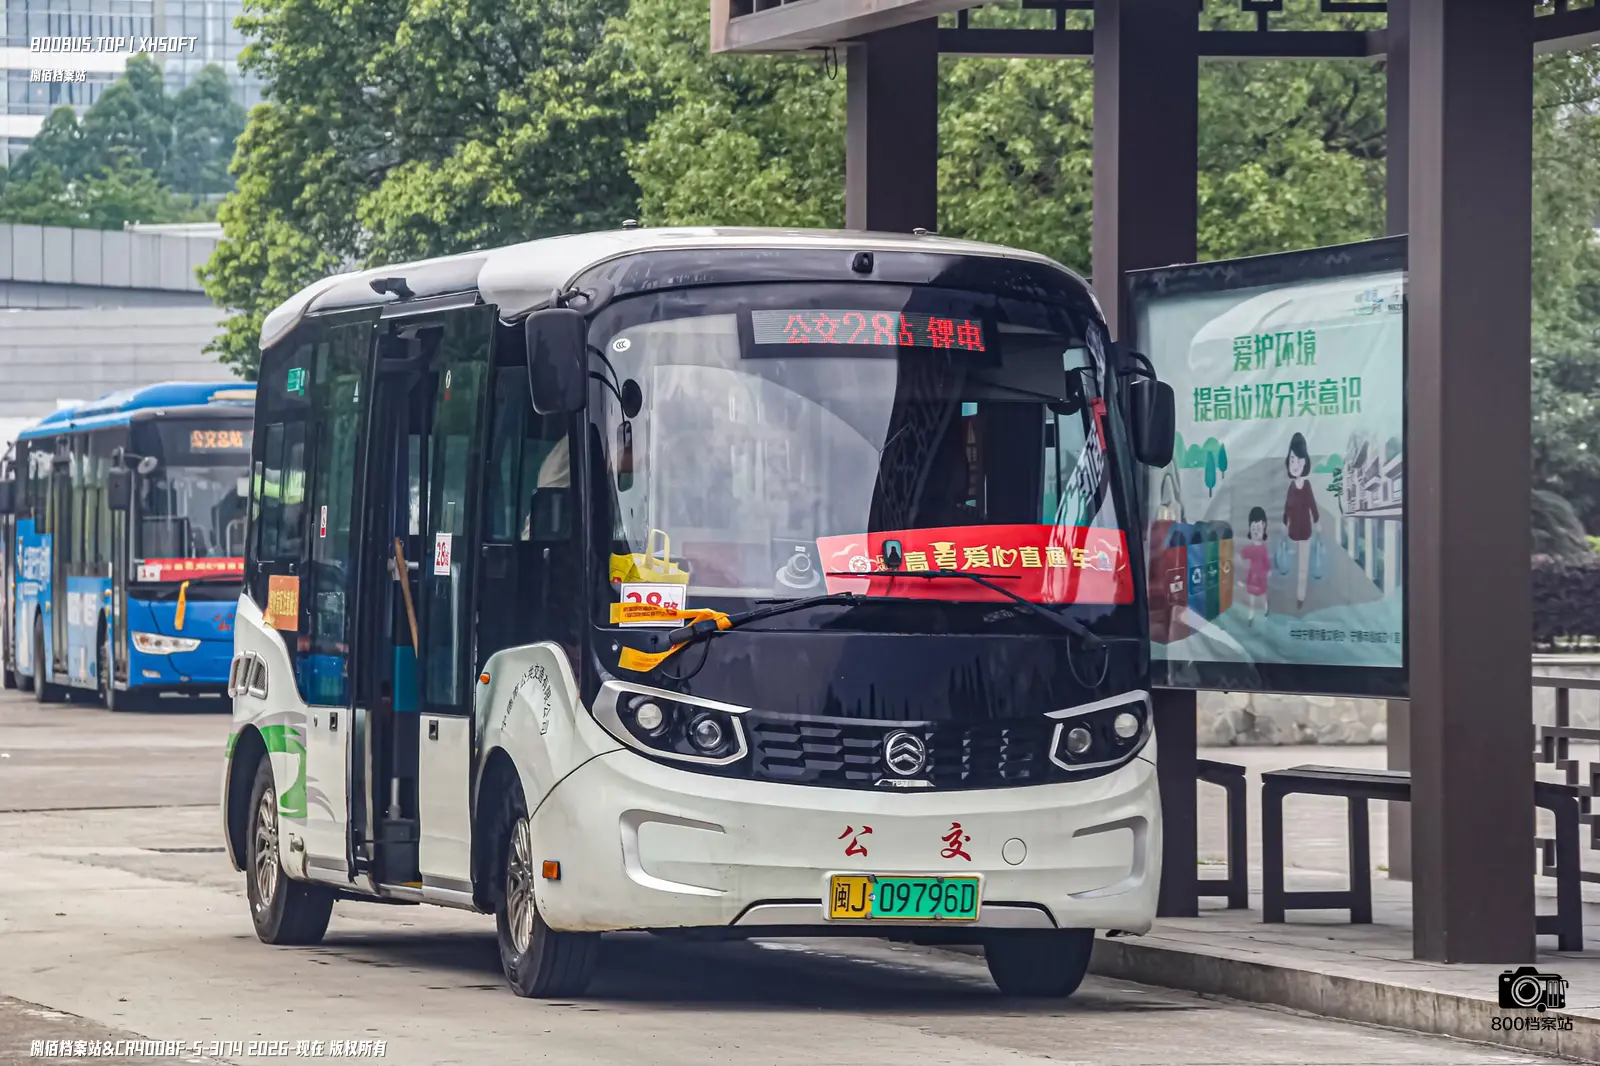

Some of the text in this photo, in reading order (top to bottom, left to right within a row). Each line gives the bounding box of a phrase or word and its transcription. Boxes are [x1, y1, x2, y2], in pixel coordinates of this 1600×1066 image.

[1233, 330, 1317, 372] 爱护环境
[1193, 376, 1362, 422] 提高垃圾分类意识
[904, 542, 1091, 572] 高考爱心直通车
[879, 883, 975, 913] 09796D
